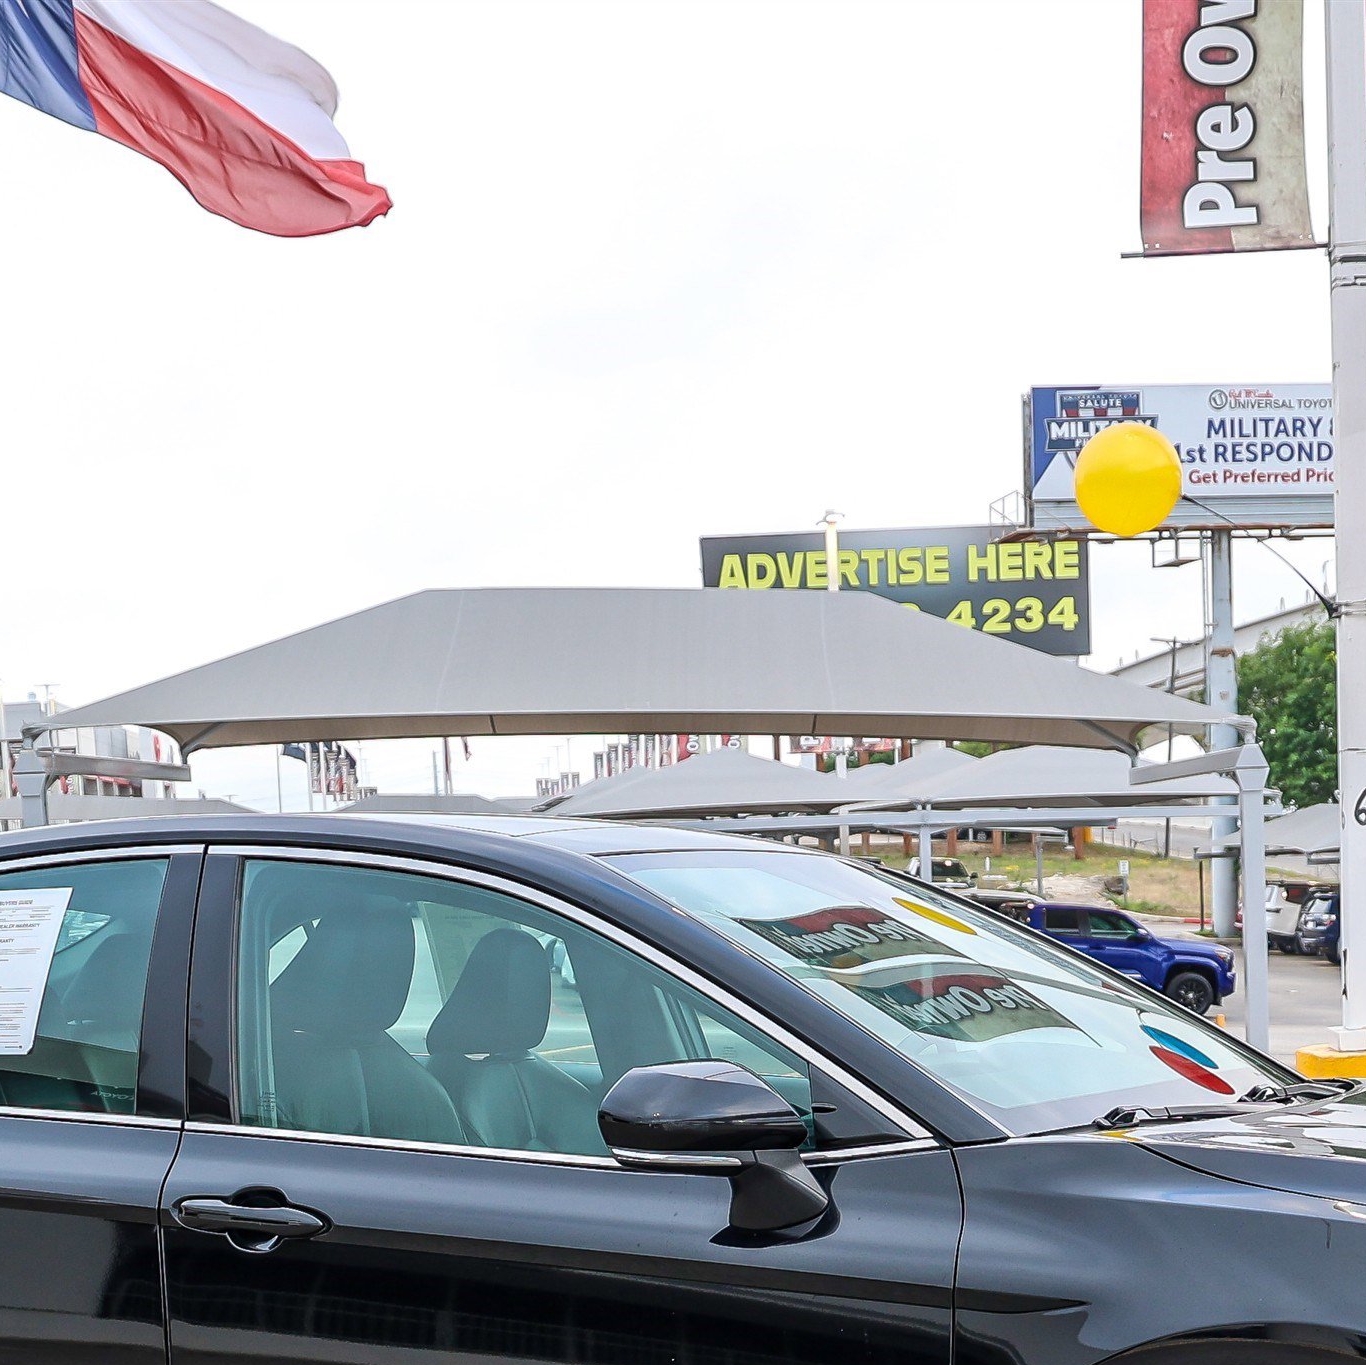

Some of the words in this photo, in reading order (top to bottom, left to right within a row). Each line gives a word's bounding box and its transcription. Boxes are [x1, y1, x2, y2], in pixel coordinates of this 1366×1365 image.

[1183, 103, 1259, 229] Pre
[1078, 398, 1122, 408] SALUTE
[1229, 399, 1295, 409] UNIVERSAL
[1298, 399, 1333, 409] TOYOT
[1050, 420, 1152, 440] MILIT
[1207, 416, 1323, 438] MILITARY
[1188, 469, 1219, 484] Get
[1223, 468, 1300, 484] Preferred
[1306, 467, 1334, 483] Pric
[718, 546, 950, 588] ADVERTISE
[968, 541, 1079, 582] HERE
